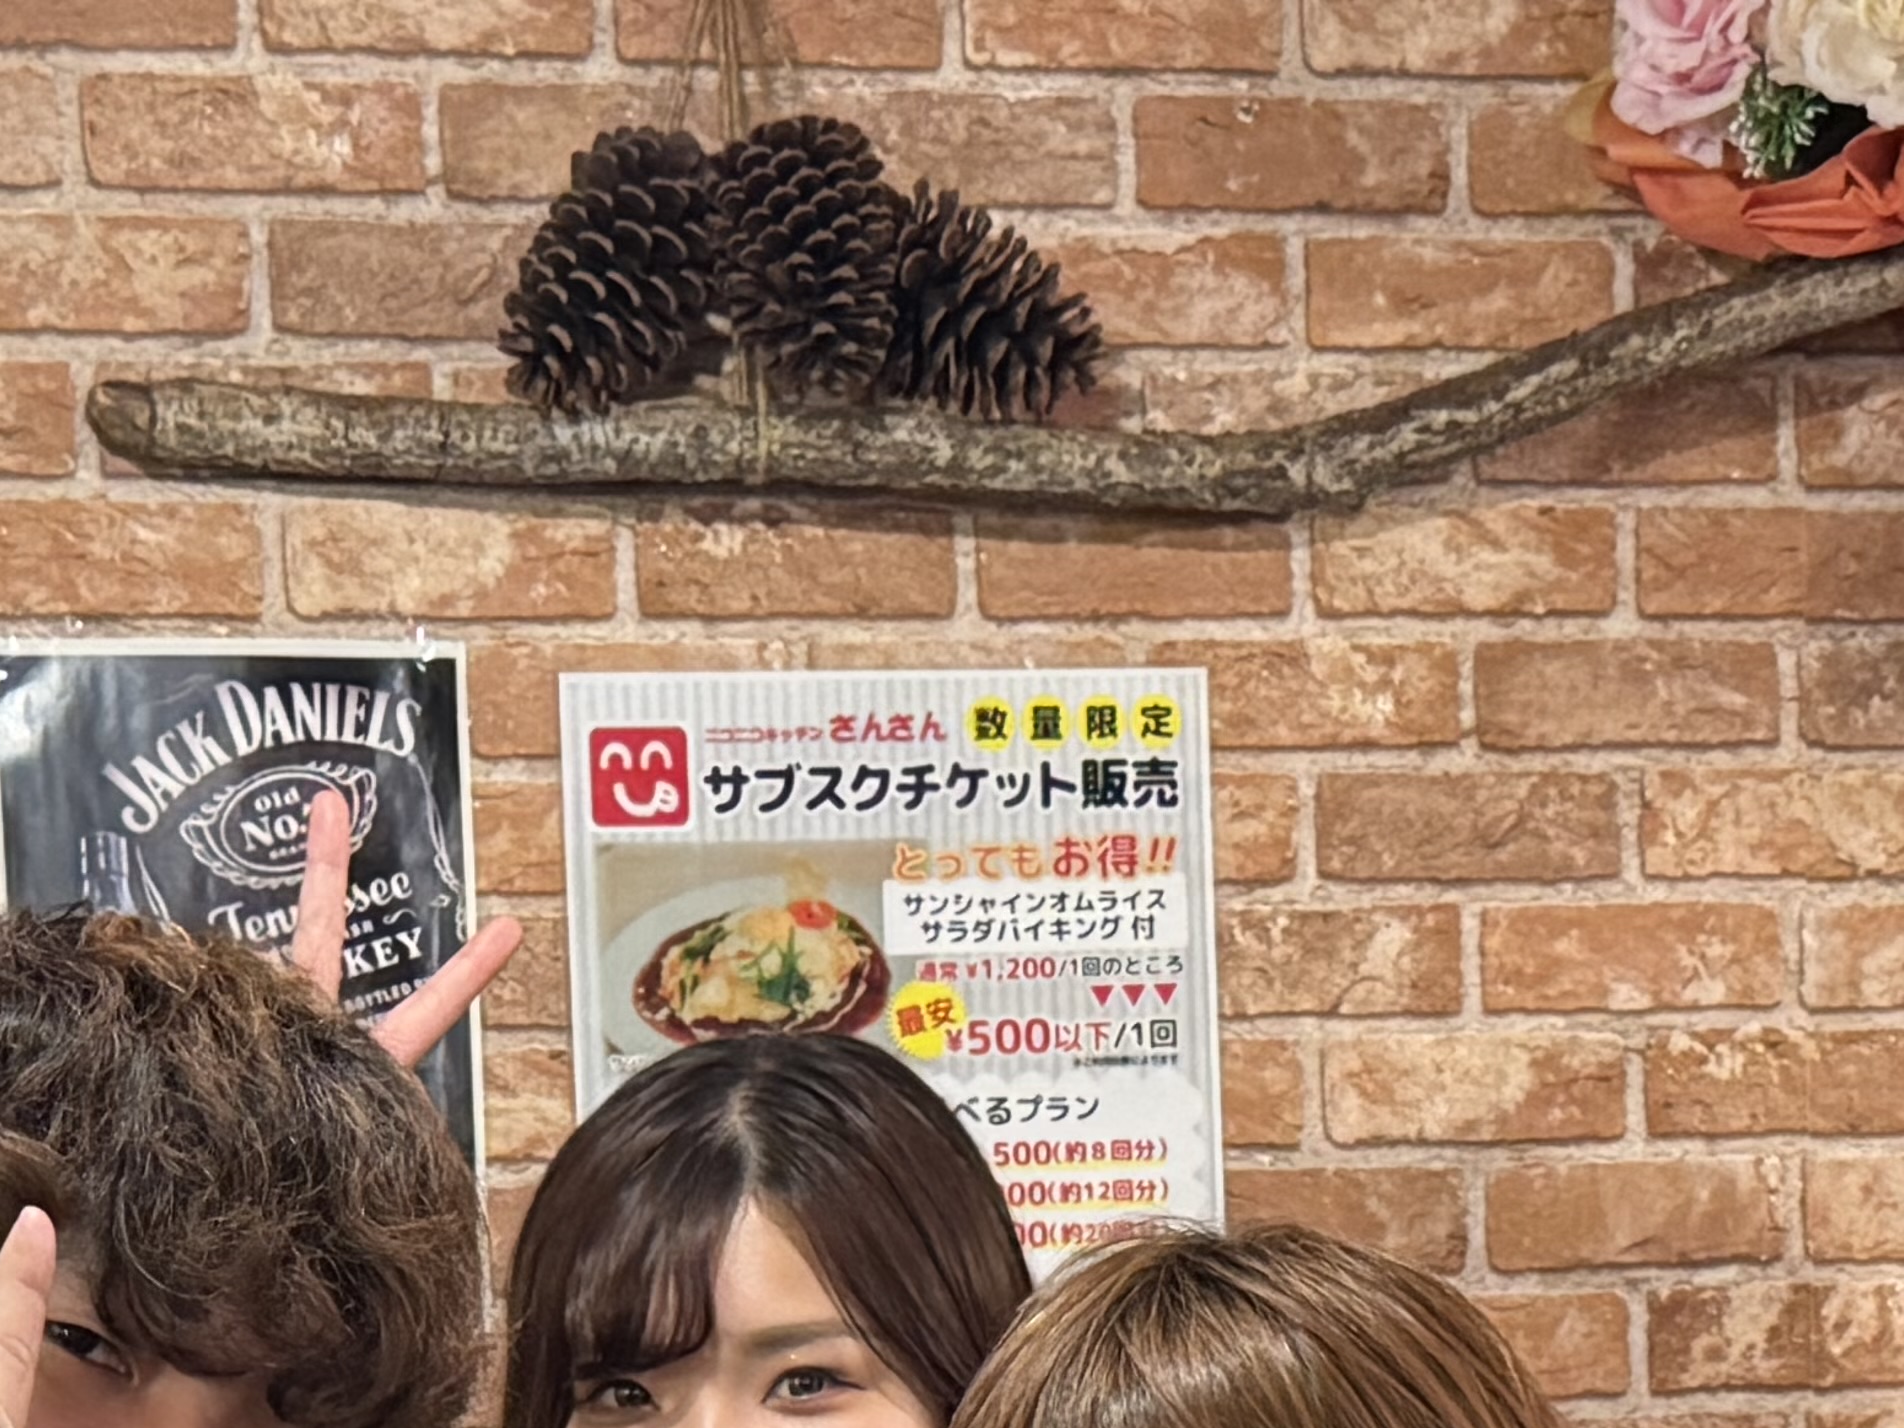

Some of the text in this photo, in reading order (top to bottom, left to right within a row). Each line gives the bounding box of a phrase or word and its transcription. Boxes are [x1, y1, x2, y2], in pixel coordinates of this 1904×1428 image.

[972, 703, 1175, 743] 数量限定
[101, 709, 232, 835] JACK
[703, 757, 1180, 815] サブスクチケット販売
[254, 786, 301, 813] Old
[240, 803, 311, 851] No.
[903, 889, 1167, 917] サンシャインオムライス
[896, 997, 957, 1038] 最安
